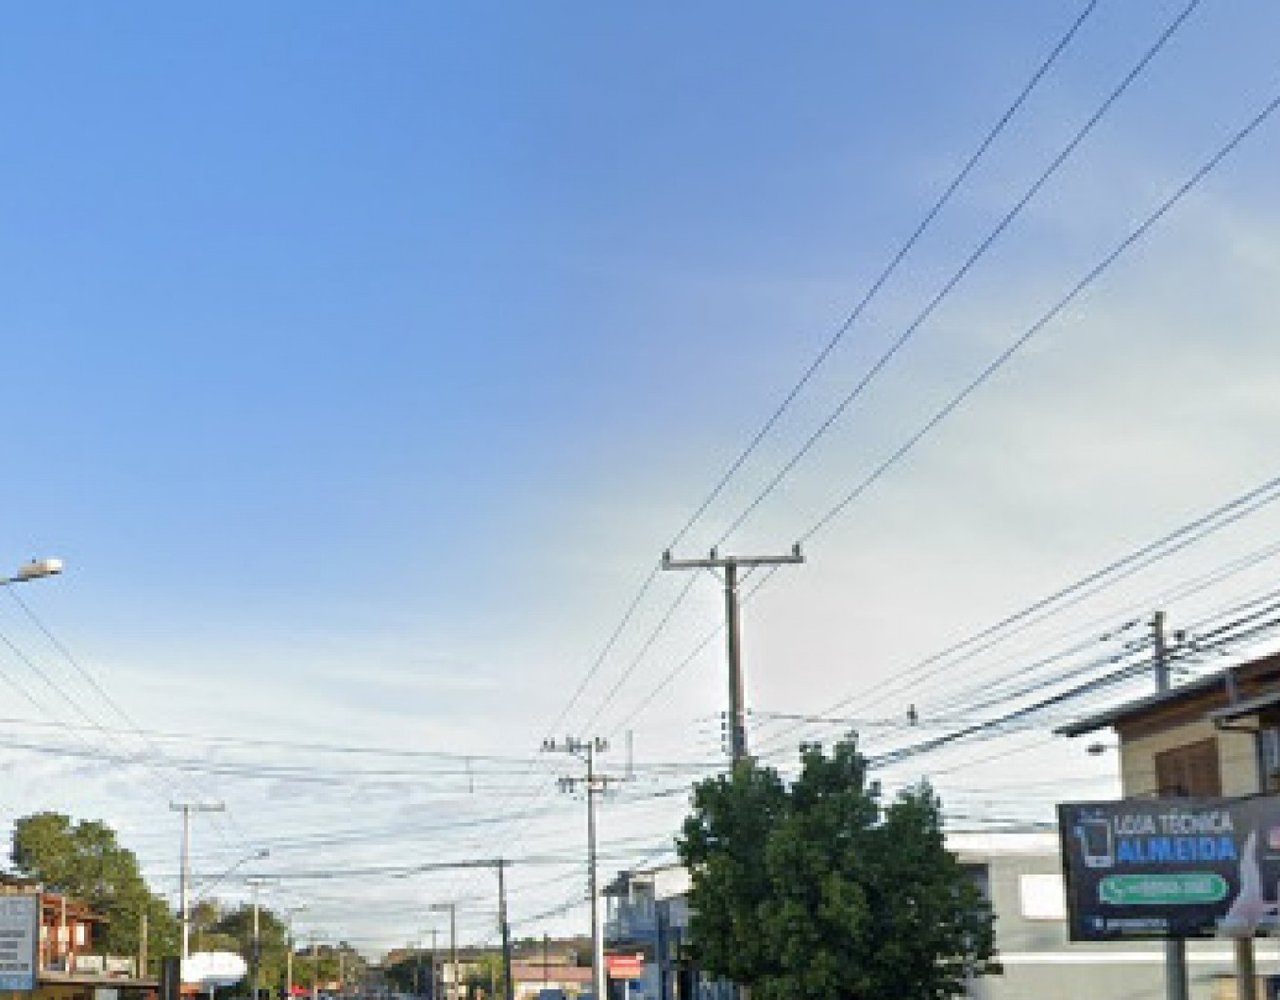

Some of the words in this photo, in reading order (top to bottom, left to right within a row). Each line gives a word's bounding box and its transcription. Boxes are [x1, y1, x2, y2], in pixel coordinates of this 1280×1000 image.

[1114, 814, 1156, 835] LOJA
[1158, 807, 1234, 834] TÉCNICA
[1117, 835, 1238, 862] ALMEIDA
